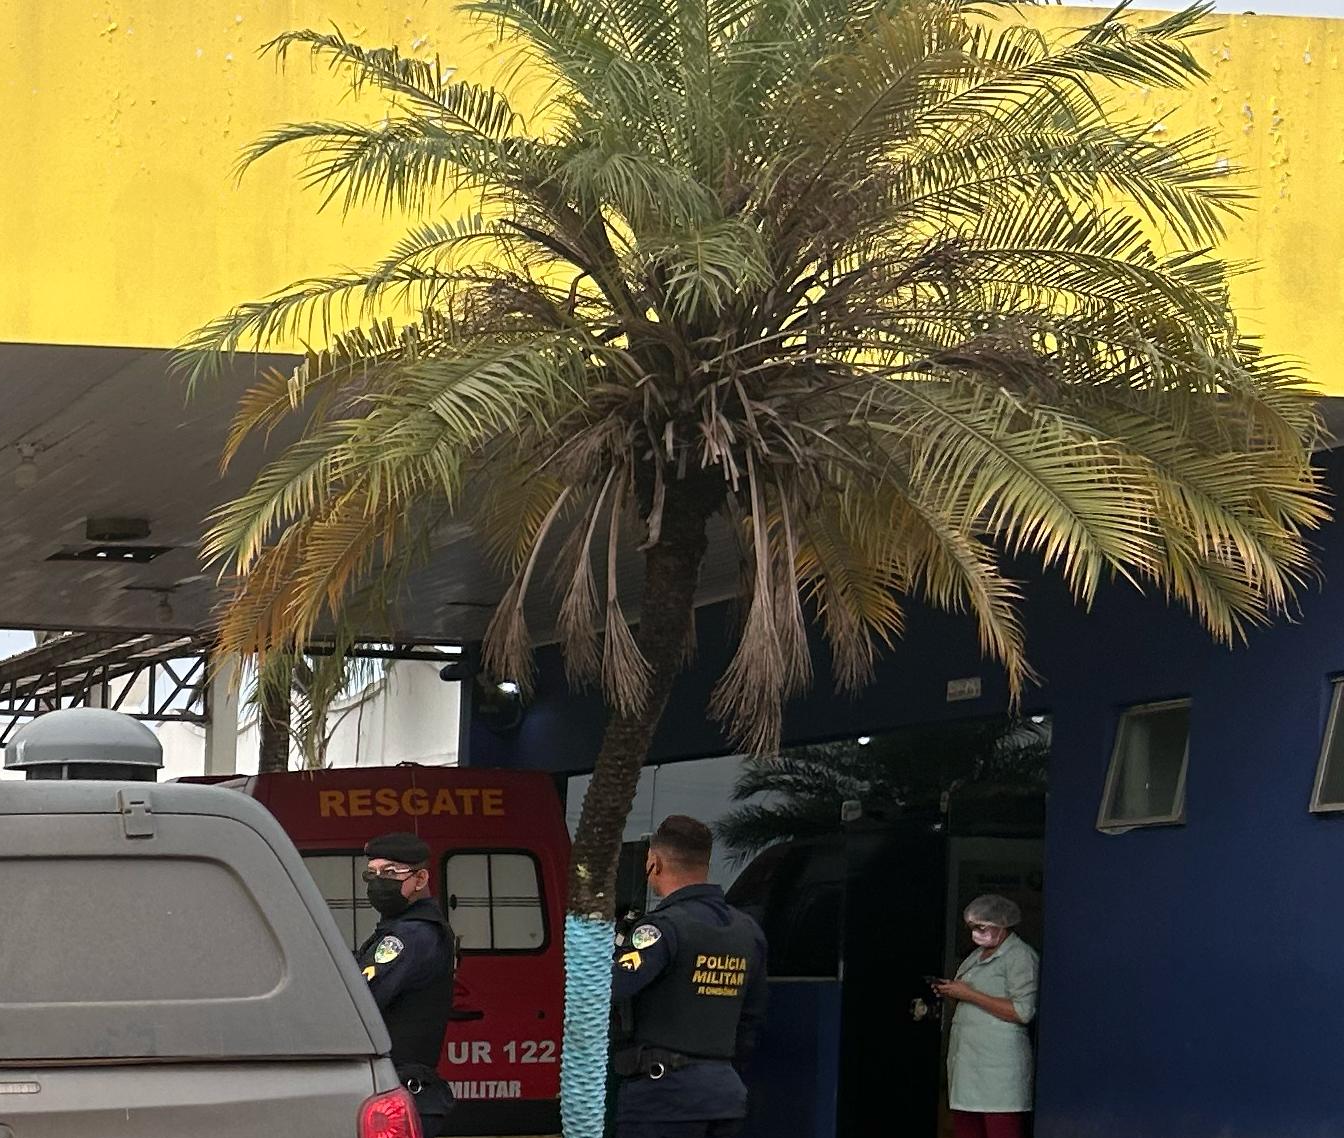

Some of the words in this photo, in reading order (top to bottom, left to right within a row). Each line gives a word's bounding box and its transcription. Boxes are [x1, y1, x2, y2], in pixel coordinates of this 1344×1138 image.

[319, 787, 505, 817] RESGATE
[695, 954, 746, 971] POLÍCIA
[692, 970, 745, 986] MILITAR
[447, 1041, 492, 1064] UR
[503, 1040, 557, 1064] 122
